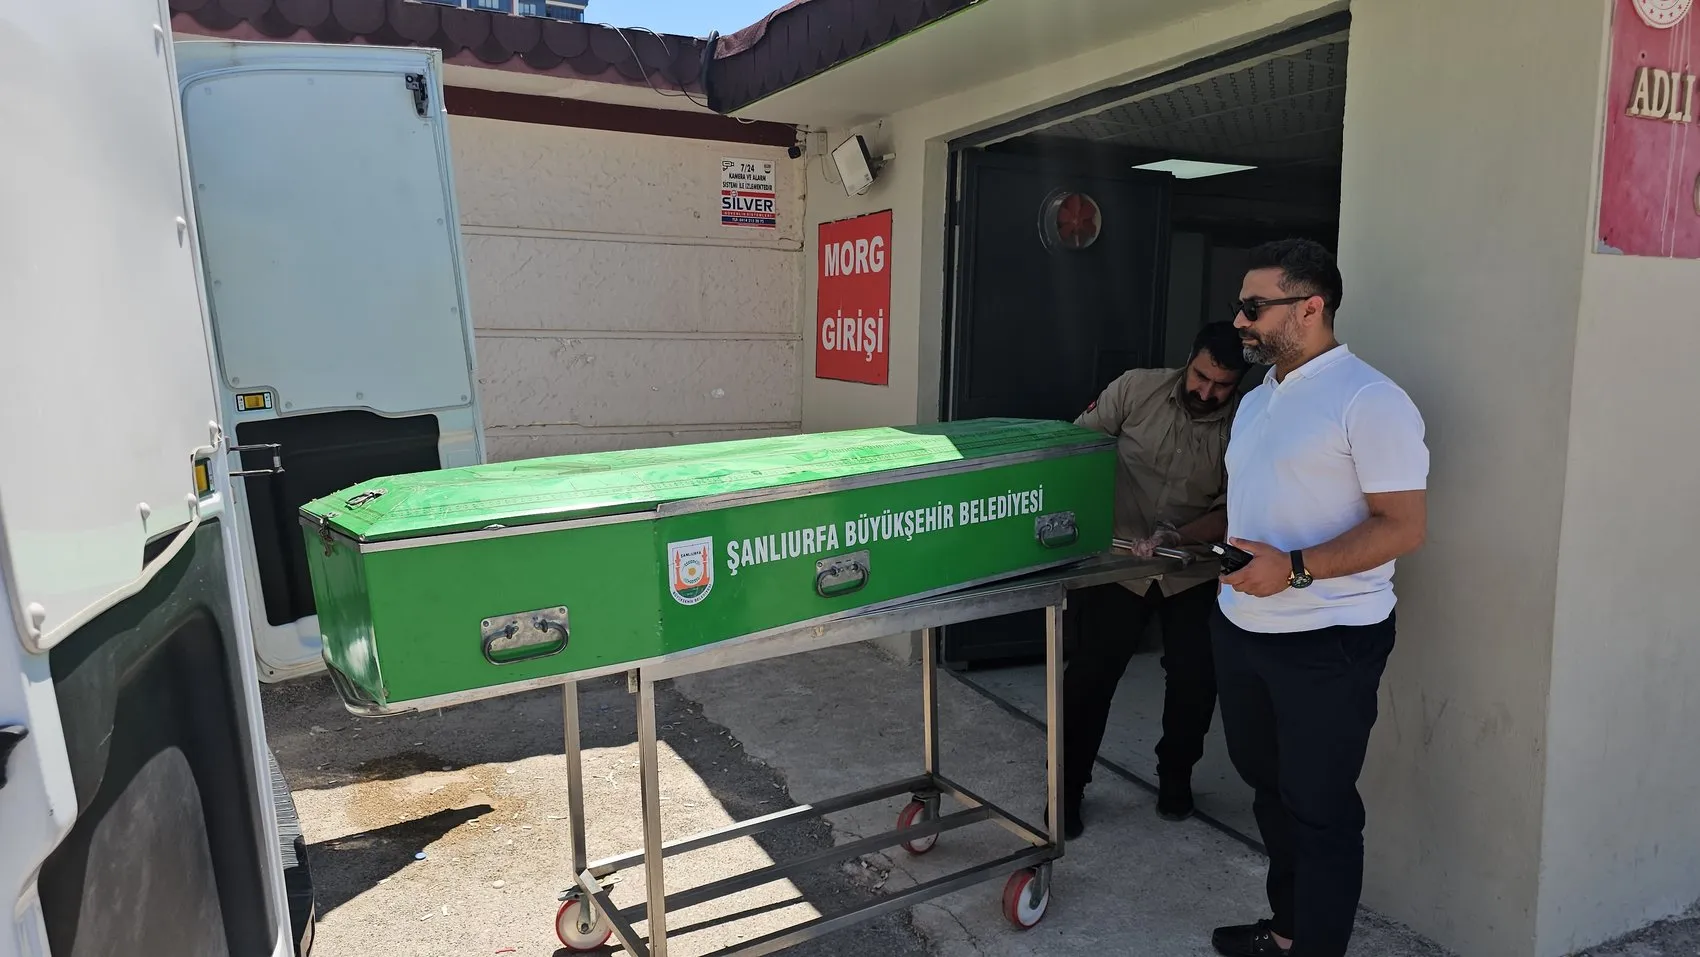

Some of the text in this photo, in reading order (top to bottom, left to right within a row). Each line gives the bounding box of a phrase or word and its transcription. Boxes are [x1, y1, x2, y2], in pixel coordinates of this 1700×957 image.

[740, 164, 755, 172] 7/24
[824, 235, 885, 277] MORG
[822, 308, 884, 362] GİRİŞİ
[727, 484, 1044, 576] ŞANLIURFA BÜYÜKŞEHİR BELEDİYESİ
